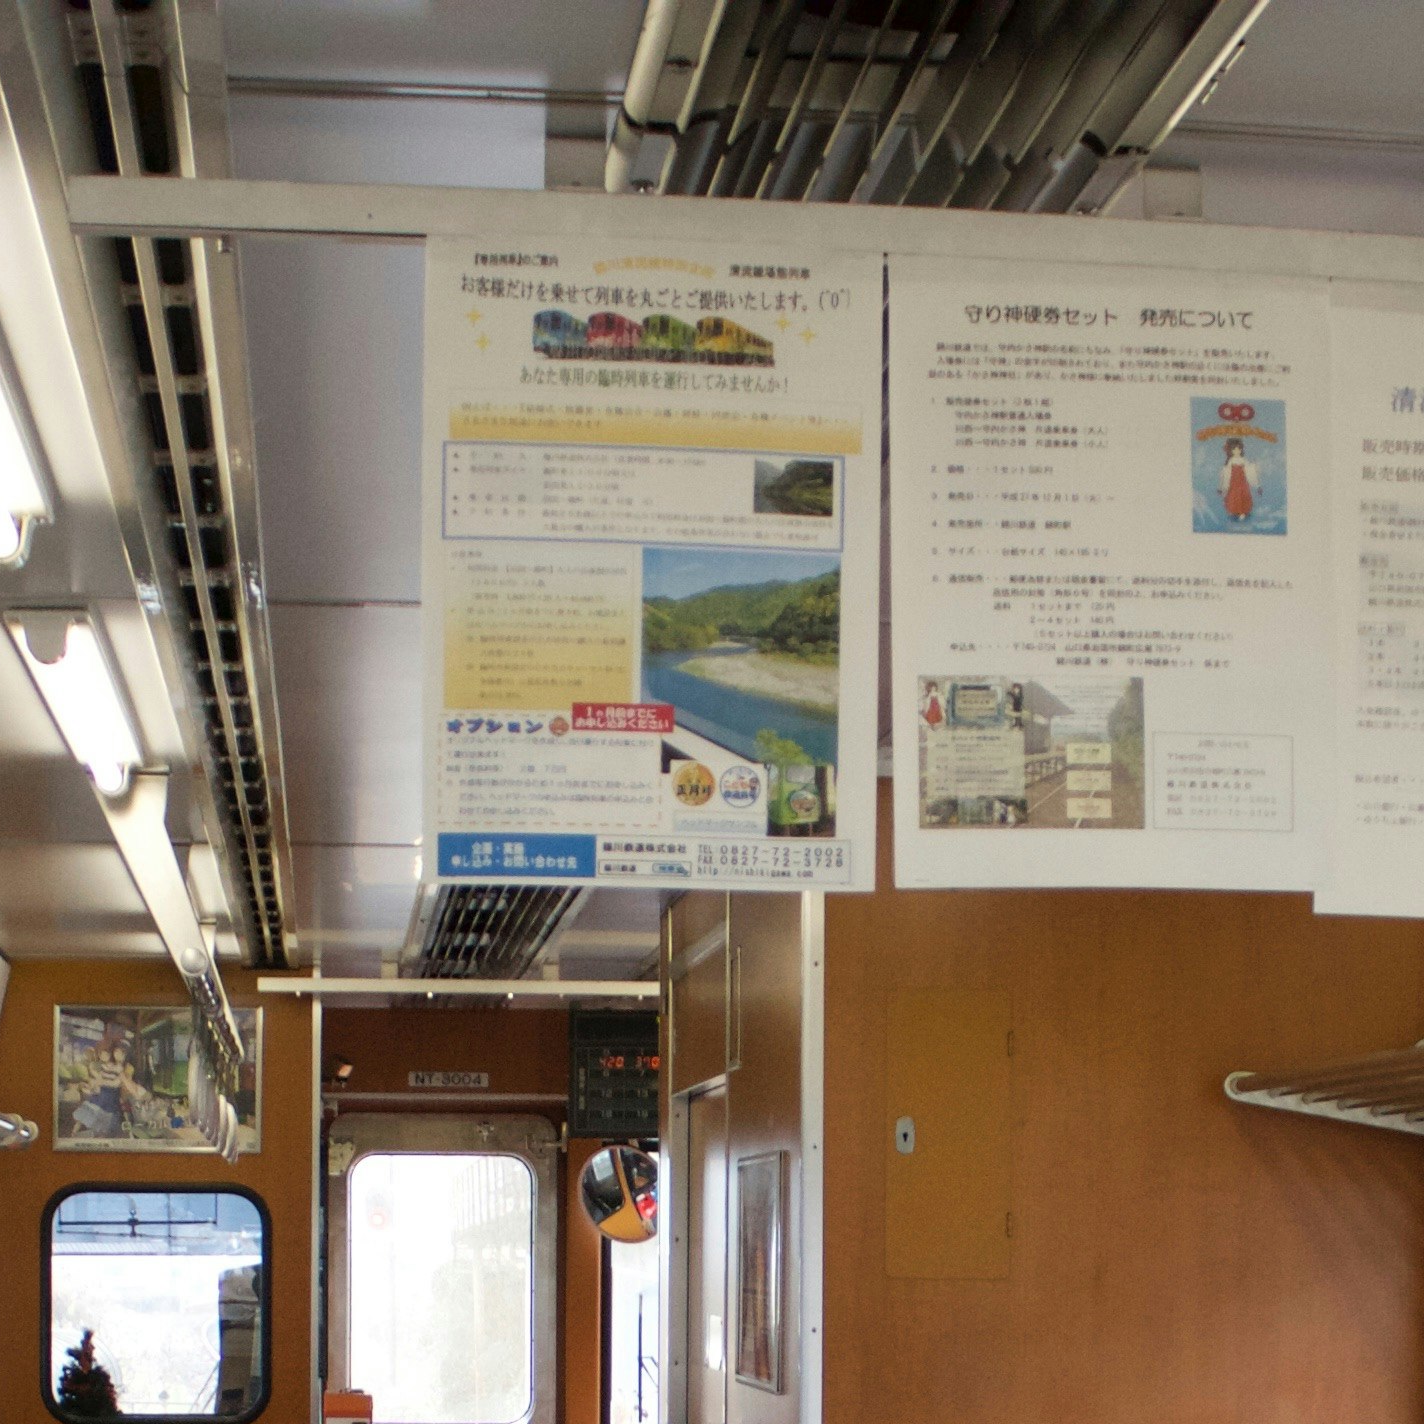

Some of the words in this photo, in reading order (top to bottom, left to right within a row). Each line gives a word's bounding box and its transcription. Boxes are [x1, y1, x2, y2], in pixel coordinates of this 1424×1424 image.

[964, 303, 1119, 328] 守り神硬券セット
[1139, 306, 1255, 330] 発売について
[445, 717, 544, 735] オプション
[698, 845, 714, 855] TEL
[719, 845, 844, 857] 0827-72-2002
[414, 1073, 482, 1086] NT-3004
